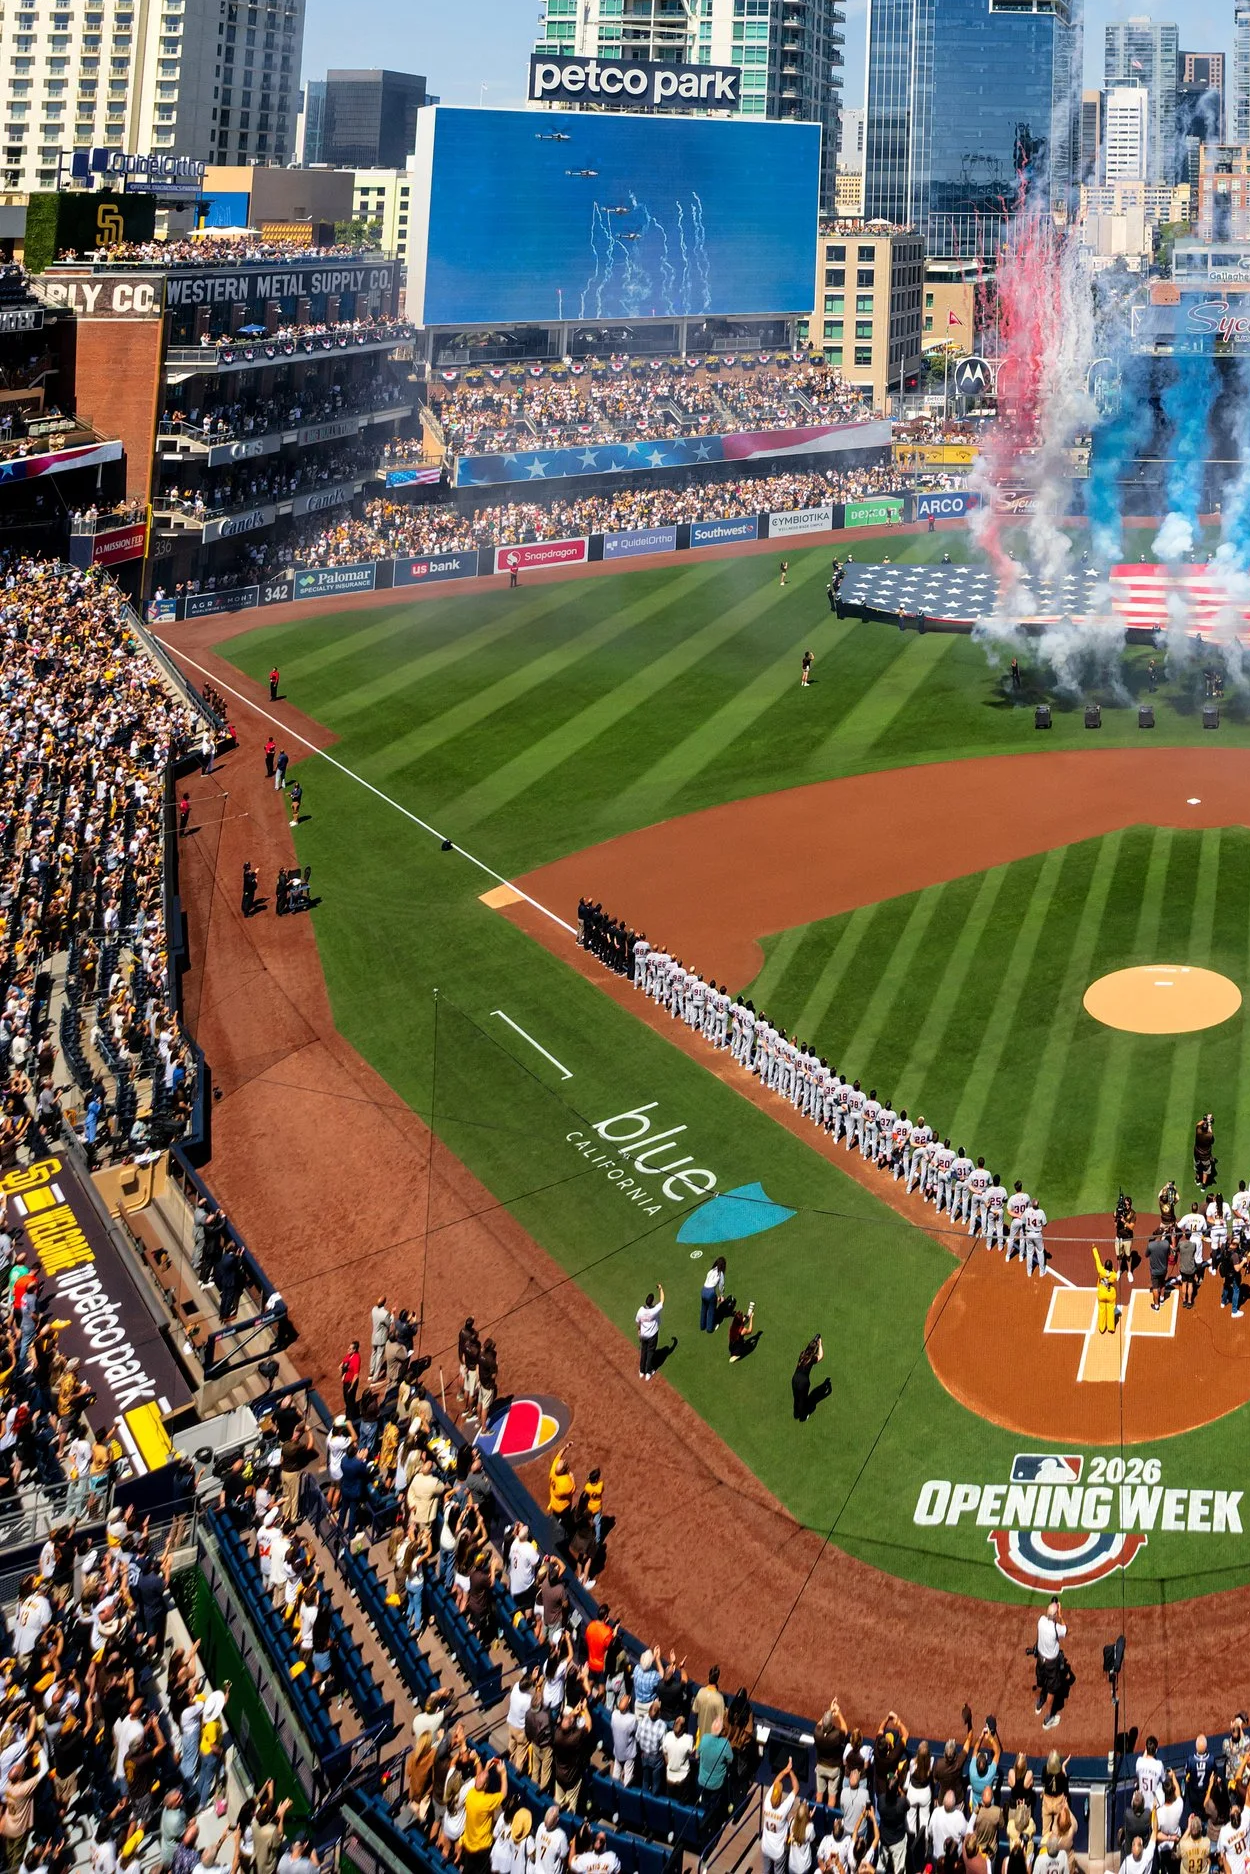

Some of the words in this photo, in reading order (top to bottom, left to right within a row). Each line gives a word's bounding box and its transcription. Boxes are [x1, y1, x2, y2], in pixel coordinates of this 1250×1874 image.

[534, 59, 648, 98] petco
[653, 70, 737, 104] park
[166, 276, 250, 305] WESTERN
[256, 273, 307, 298] METAL
[311, 269, 366, 295] SUPPLY
[369, 269, 391, 290] CO.
[112, 283, 161, 313] CO.
[919, 498, 964, 515] ARCO
[771, 511, 830, 526] CYMBIOTIKA
[694, 524, 747, 540] Southwest
[103, 538, 131, 553] MISSION
[131, 534, 144, 545] FED
[154, 538, 172, 557] 336
[620, 534, 673, 549] QuidelOrtho
[524, 546, 578, 562] Snapdragon
[412, 564, 428, 575] us
[429, 558, 461, 573] bank
[318, 569, 371, 585] Palomar
[264, 584, 289, 602] 342
[300, 584, 334, 594] SPECIALTY
[335, 579, 371, 590] INSURANCE
[635, 948, 644, 956] 88
[672, 974, 682, 982] 92
[694, 988, 702, 996] 91
[849, 1099, 859, 1109] 38
[880, 1118, 891, 1127] 37
[897, 1127, 907, 1137] 28
[914, 1135, 926, 1145] 22
[591, 1101, 718, 1202] blue
[939, 1160, 950, 1169] 20
[957, 1167, 966, 1176] 31
[565, 1130, 663, 1217] CALIFORNIA
[973, 1179, 985, 1188] 33
[990, 1197, 1001, 1207] 25
[1014, 1204, 1026, 1214] 30
[1027, 1217, 1037, 1227] 14
[23, 1204, 98, 1278] WELCOME
[54, 1276, 127, 1350] petco
[84, 1341, 157, 1412] park
[1086, 1456, 1162, 1484] 2026
[912, 1479, 1114, 1529] OPENING
[1118, 1484, 1245, 1534] WEEK
[1141, 1777, 1154, 1793] 51
[1188, 1857, 1204, 1874] 23
